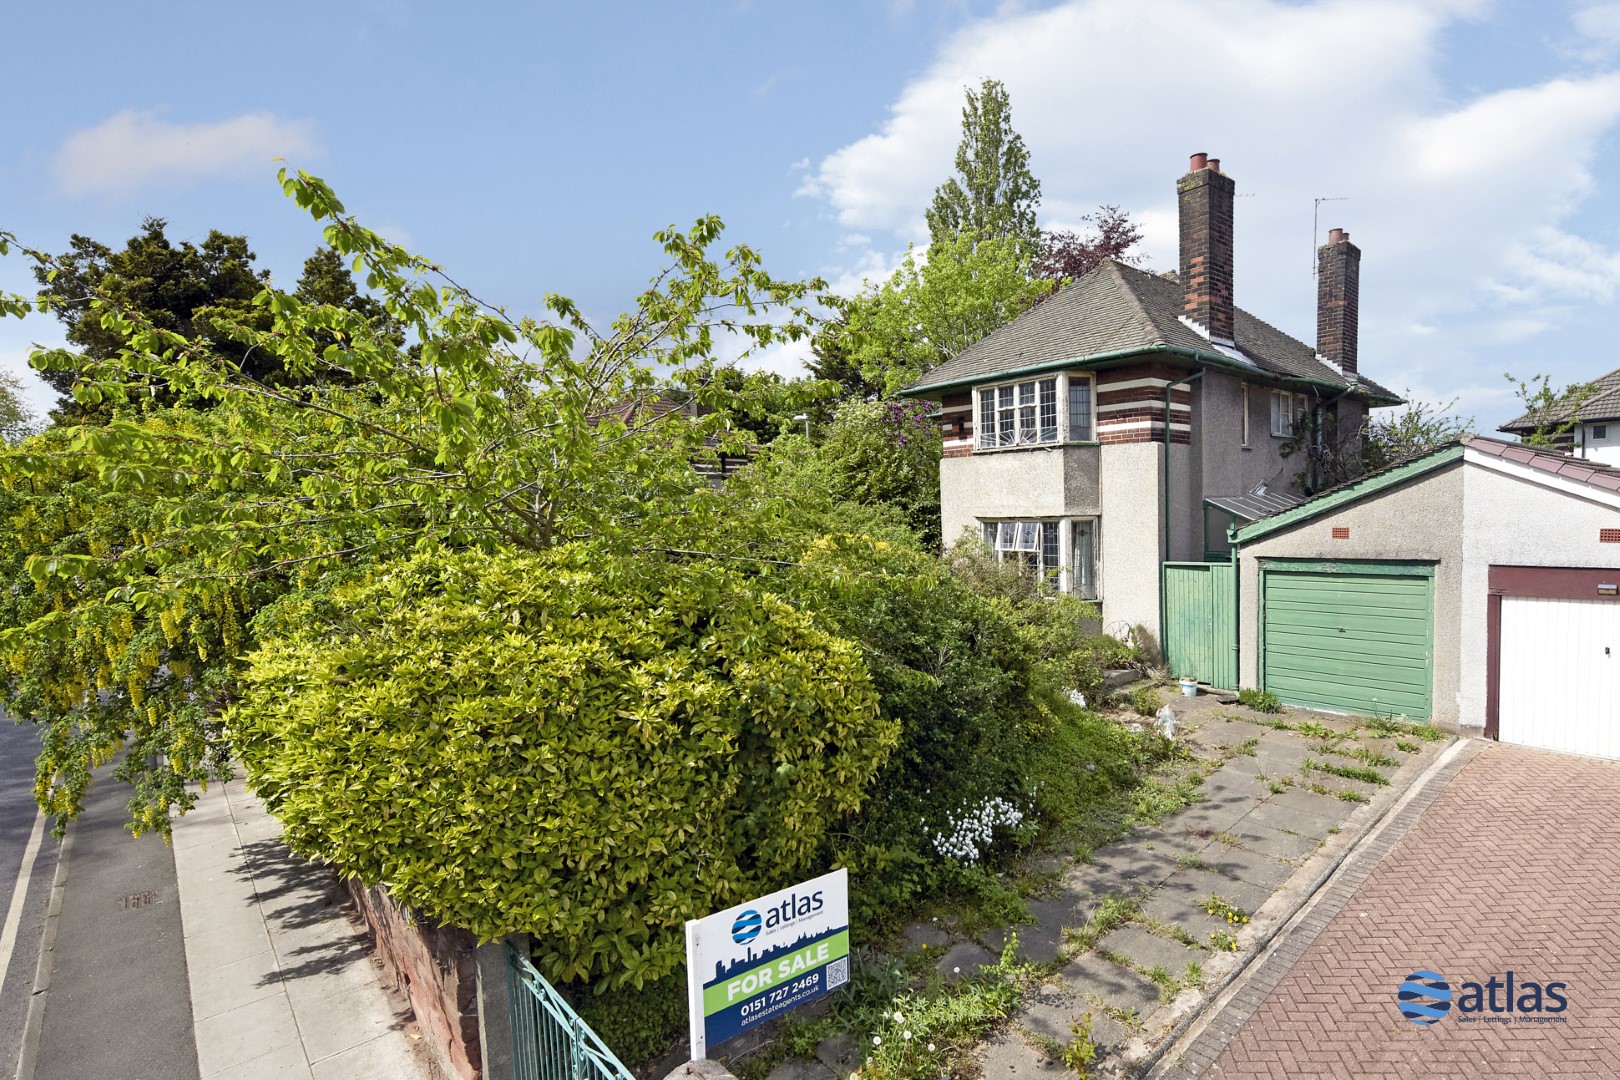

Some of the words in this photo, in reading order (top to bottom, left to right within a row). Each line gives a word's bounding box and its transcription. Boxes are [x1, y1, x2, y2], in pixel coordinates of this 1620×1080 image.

[765, 928, 777, 936] Sales
[798, 910, 823, 923] Management
[766, 891, 823, 928] atlas
[727, 968, 772, 1002] FOR
[778, 943, 829, 979] SALE
[741, 997, 766, 1016] 0151
[769, 986, 789, 1006] 727
[791, 973, 819, 993] 2469
[741, 984, 819, 1026] atlasestateagents.co.uk
